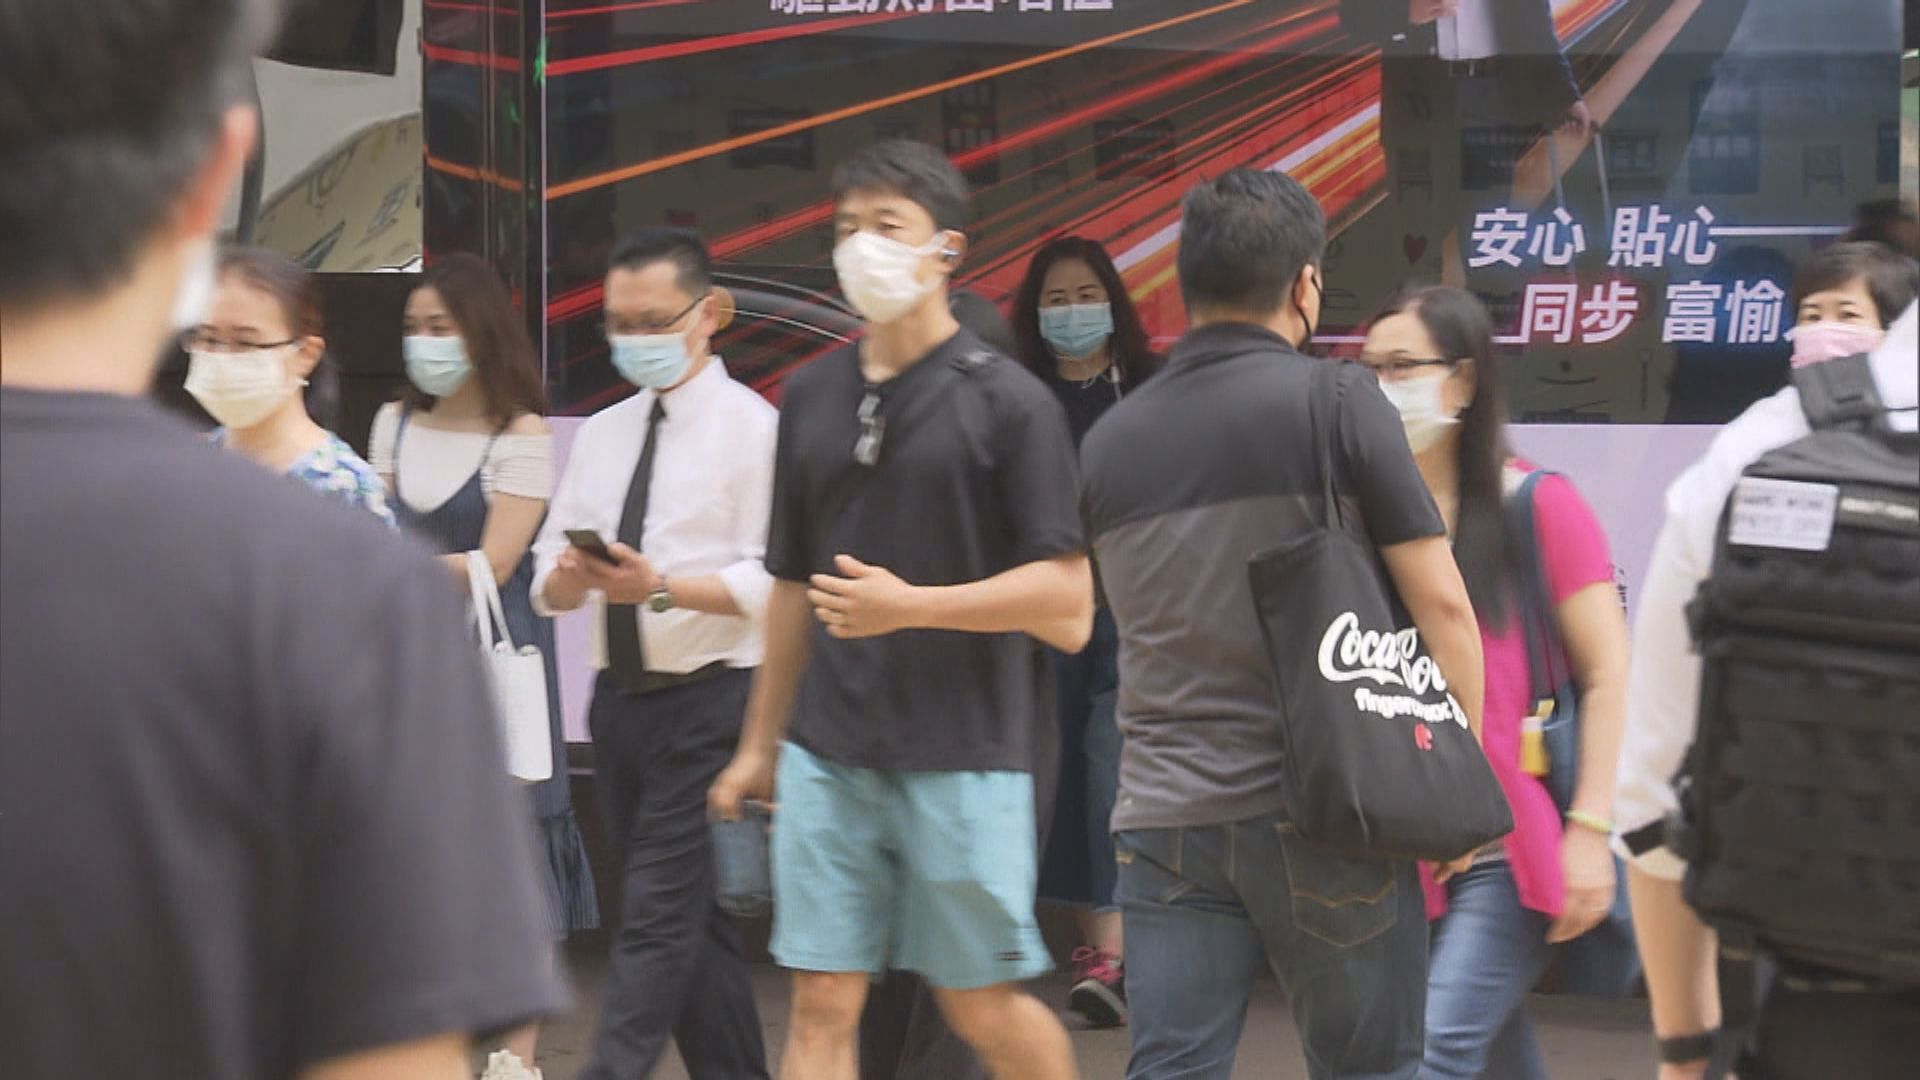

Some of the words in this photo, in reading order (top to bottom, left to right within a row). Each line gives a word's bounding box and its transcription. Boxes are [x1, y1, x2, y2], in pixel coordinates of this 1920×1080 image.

[1468, 207, 1586, 267] 安心
[1608, 205, 1718, 267] 貼心
[1520, 281, 1639, 343] 同步
[1662, 279, 1793, 343] 富愉
